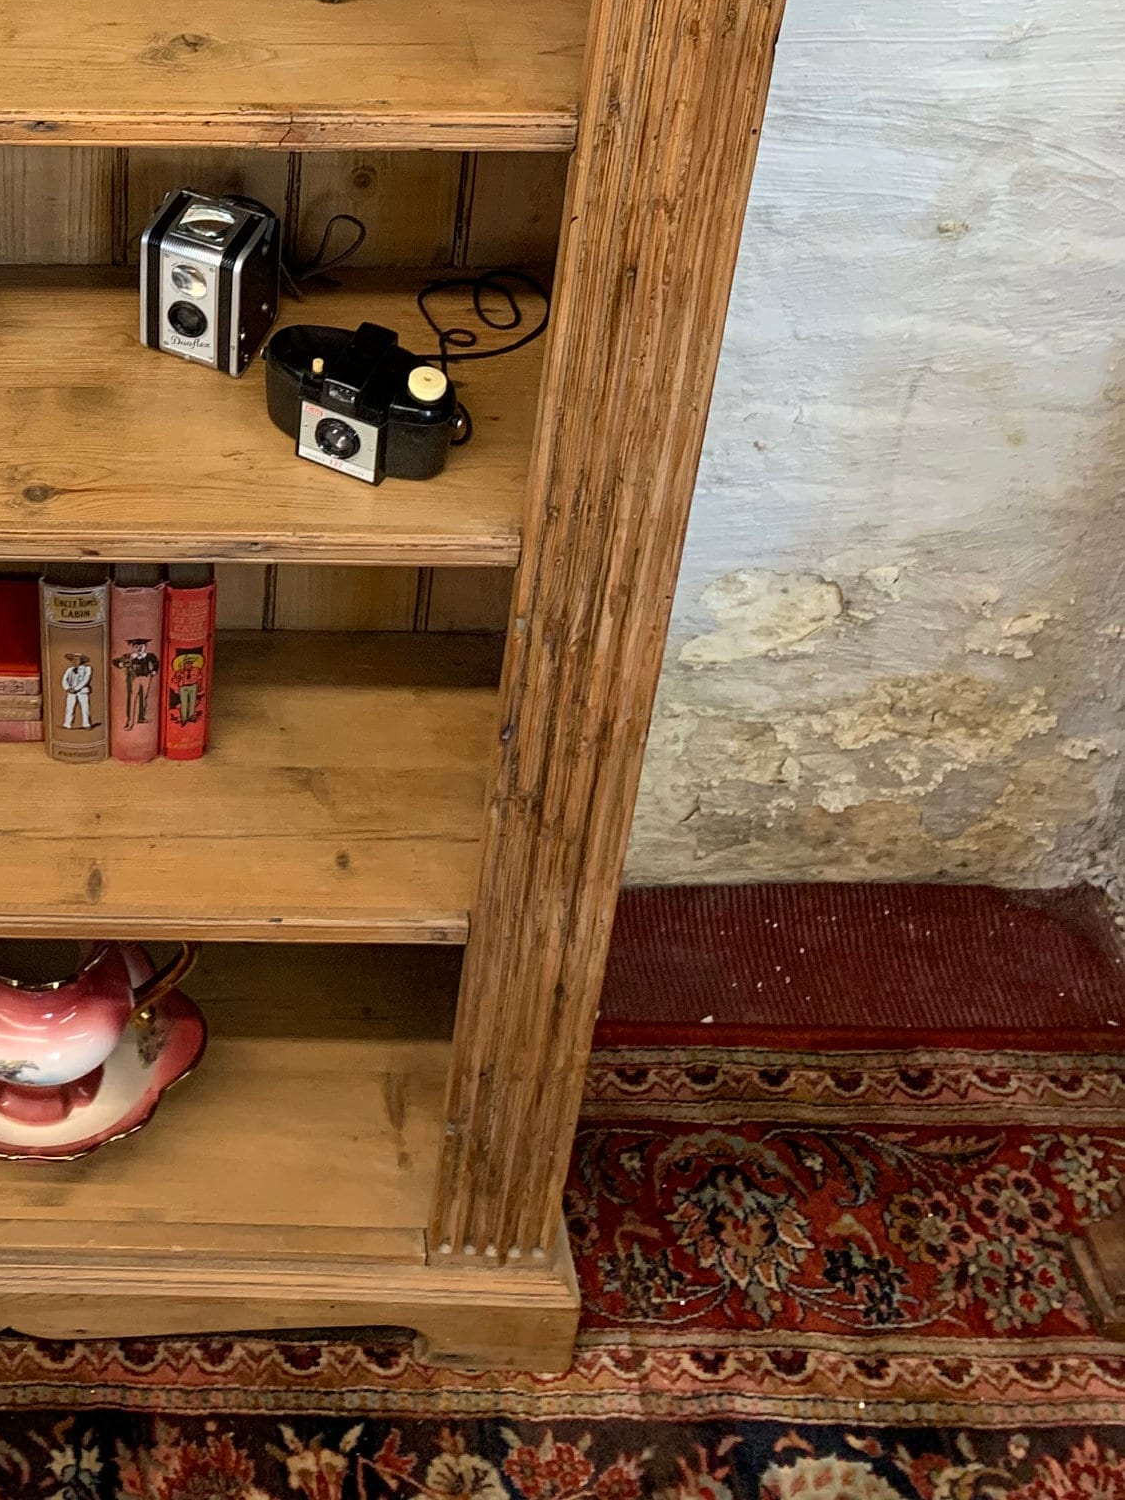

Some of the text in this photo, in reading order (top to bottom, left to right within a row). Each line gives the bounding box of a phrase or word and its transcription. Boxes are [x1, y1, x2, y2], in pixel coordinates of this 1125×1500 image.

[170, 334, 212, 350] Duaflex
[53, 597, 77, 609] UNCLE
[61, 608, 91, 619] CABIN
